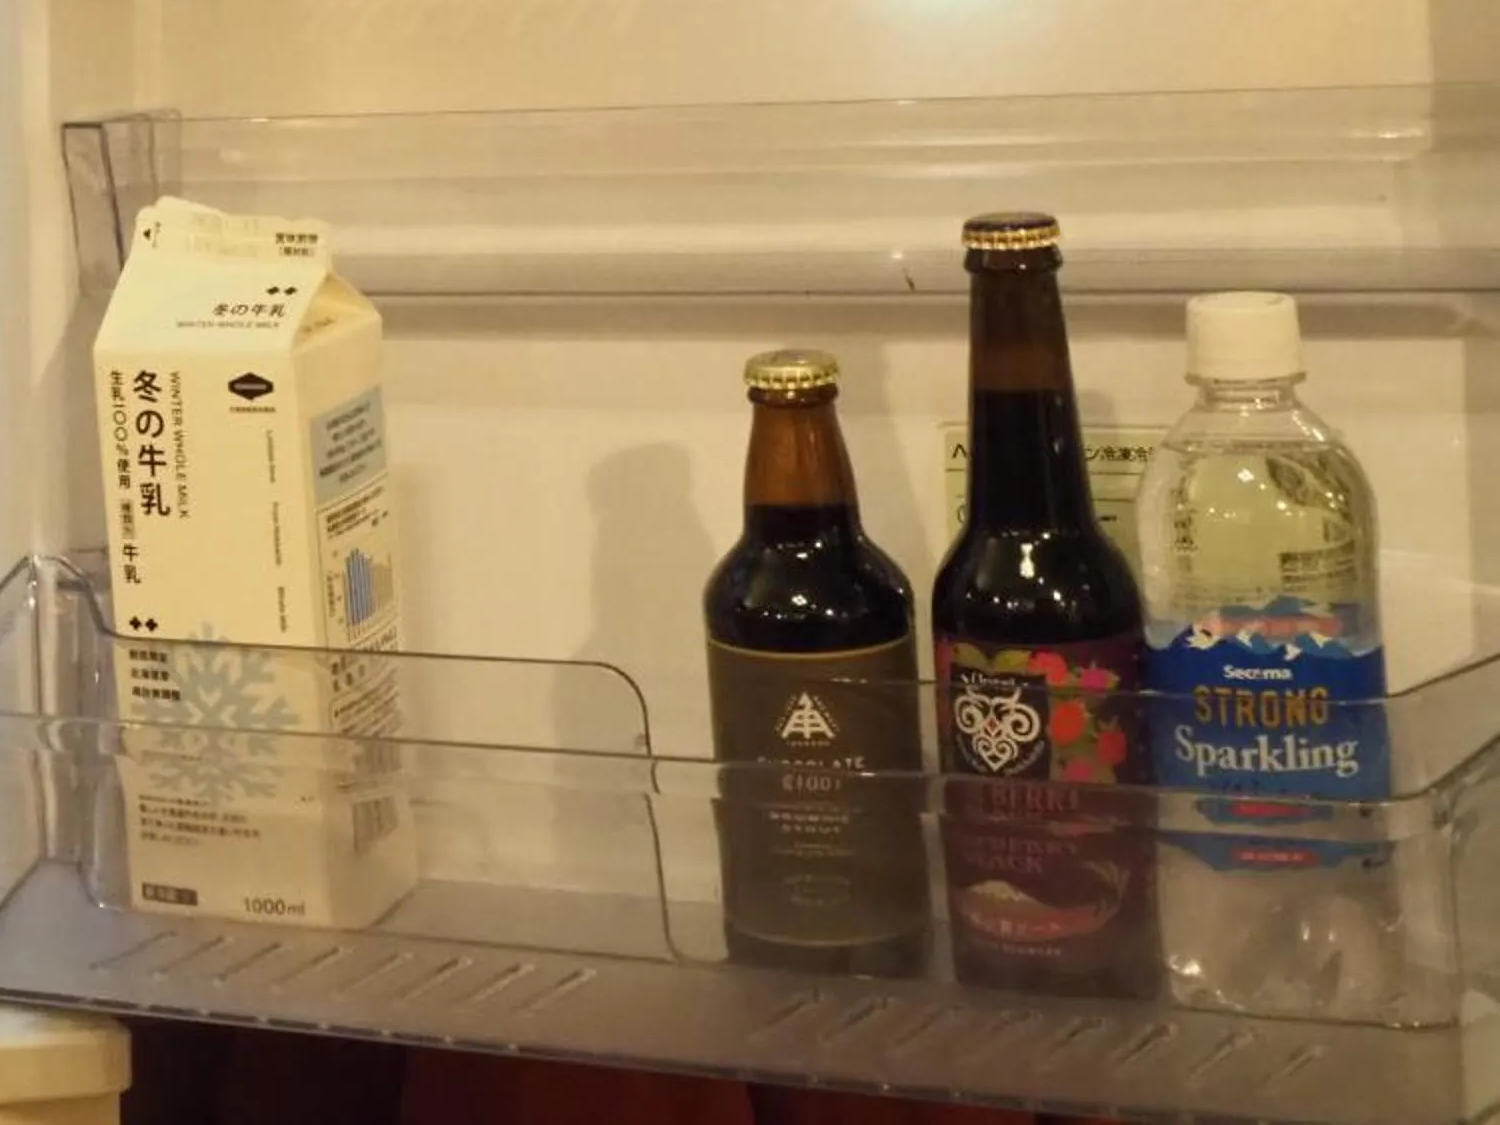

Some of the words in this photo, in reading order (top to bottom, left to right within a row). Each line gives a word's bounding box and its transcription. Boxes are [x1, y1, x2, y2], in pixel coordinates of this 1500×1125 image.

[212, 303, 287, 318] 冬の牛乳
[132, 369, 171, 517] 冬の牛乳
[122, 542, 142, 585] 牛乳
[1222, 663, 1294, 681] Secoma
[1192, 683, 1331, 730] STRONG
[1173, 723, 1361, 779] Sparkling
